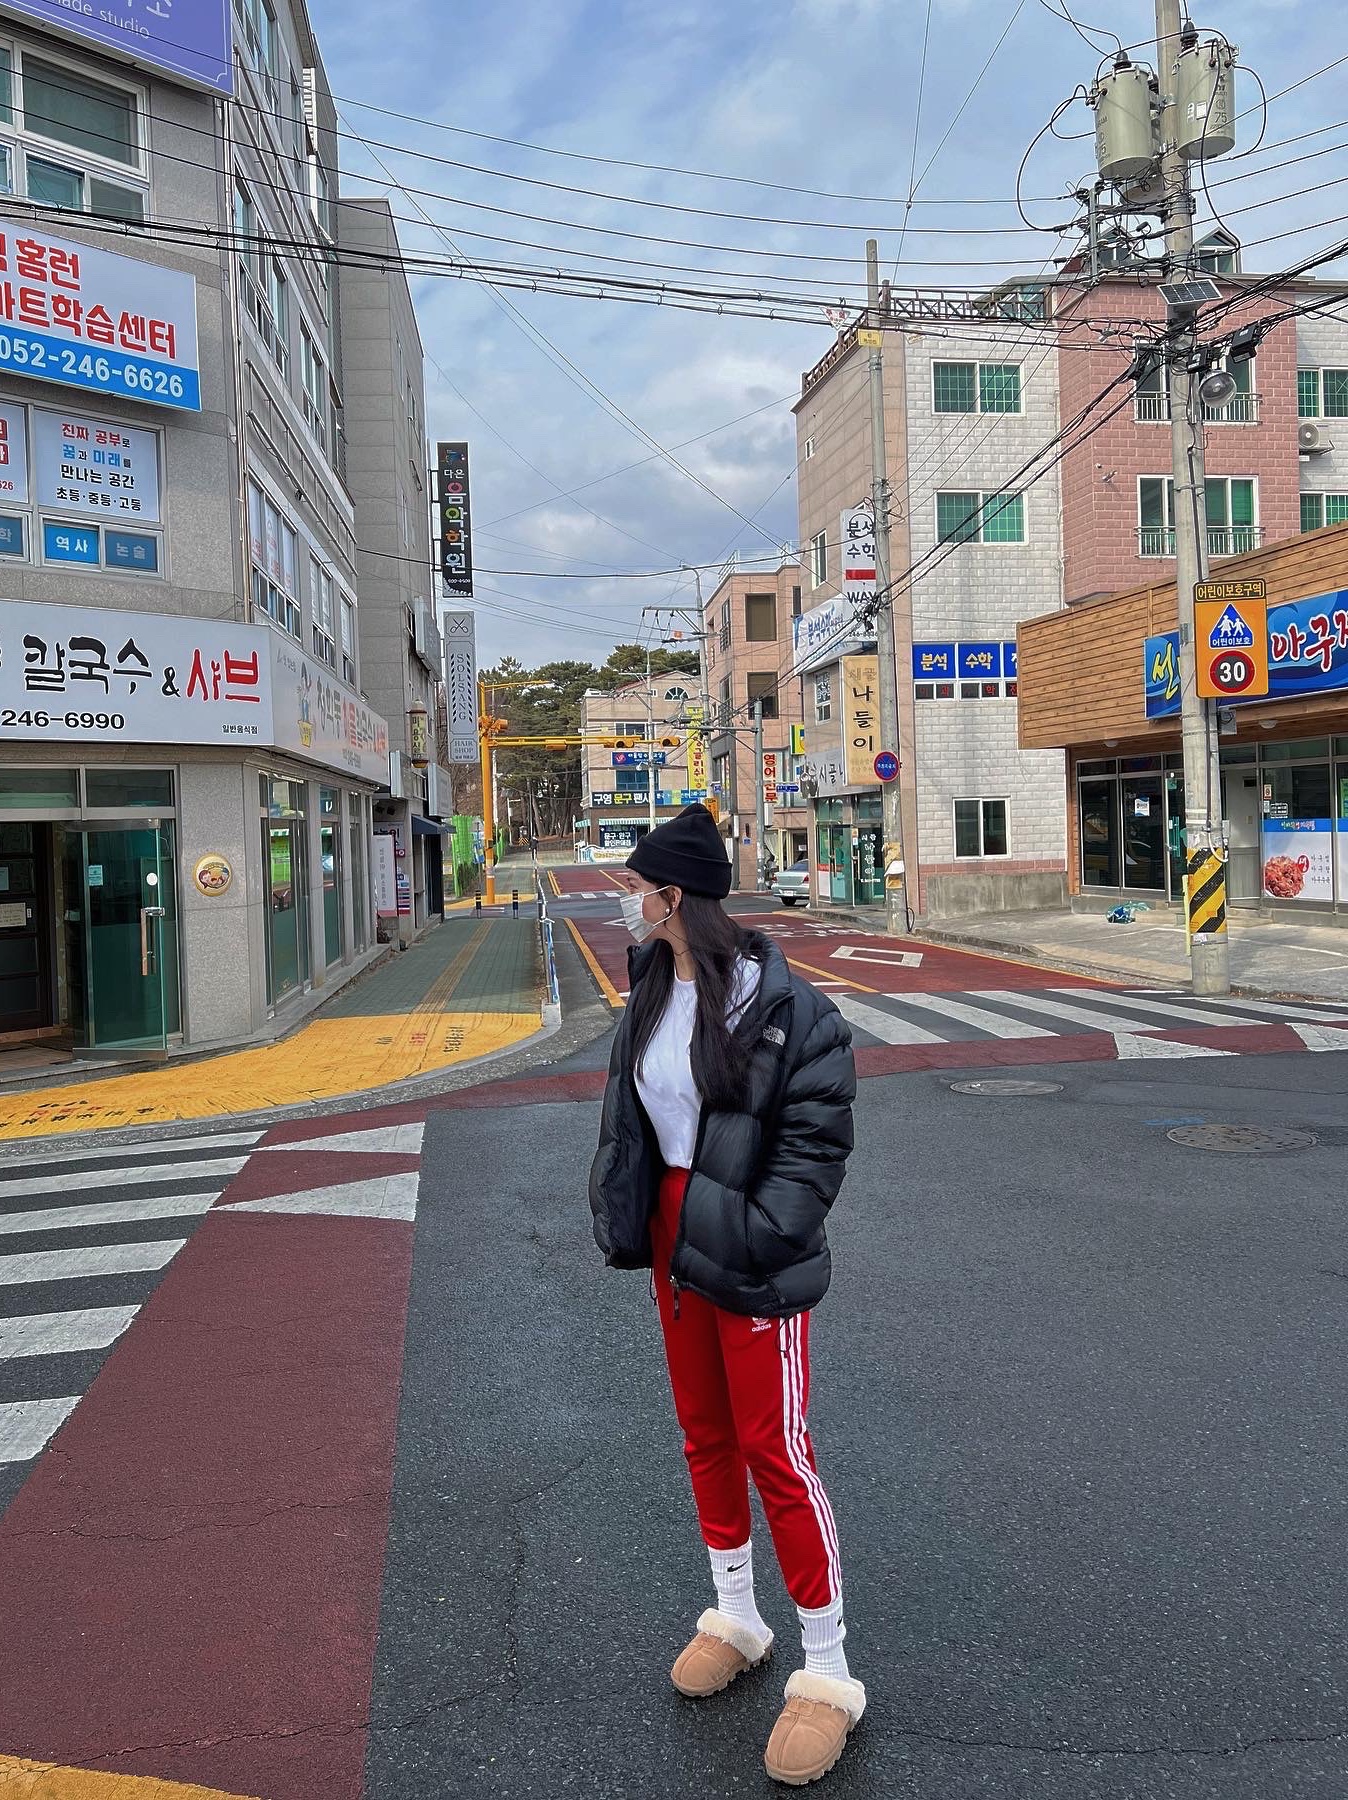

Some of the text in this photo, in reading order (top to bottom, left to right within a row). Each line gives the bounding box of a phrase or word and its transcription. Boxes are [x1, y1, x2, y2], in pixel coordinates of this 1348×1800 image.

[99, 8, 150, 39] studio
[15, 238, 81, 291] 홈런
[0, 334, 184, 398] 052-246-6626
[61, 423, 131, 448] 진짜 공부로
[62, 443, 132, 469] 꿈과 미래를
[60, 464, 135, 490] 만나는 공간
[444, 469, 465, 479] 다온
[445, 482, 467, 573] 음악학원
[55, 535, 89, 553] 역사
[116, 542, 146, 560] 논술
[1199, 583, 1262, 599] 어린이보호구역
[1212, 636, 1251, 646] 어린이보호
[22, 634, 153, 696] 칼국수
[161, 666, 181, 698] &
[186, 648, 261, 703] 샤브
[921, 653, 948, 671] 분석
[965, 652, 993, 670] 수학
[1219, 661, 1246, 683] 30
[457, 653, 466, 720] SOLSANG
[1, 709, 126, 731] 246-6990
[222, 724, 259, 735] 일반음식점
[852, 685, 874, 752] 나들이
[594, 792, 612, 805] 구영
[613, 791, 633, 804] 문구
[751, 1323, 772, 1333] adidas
